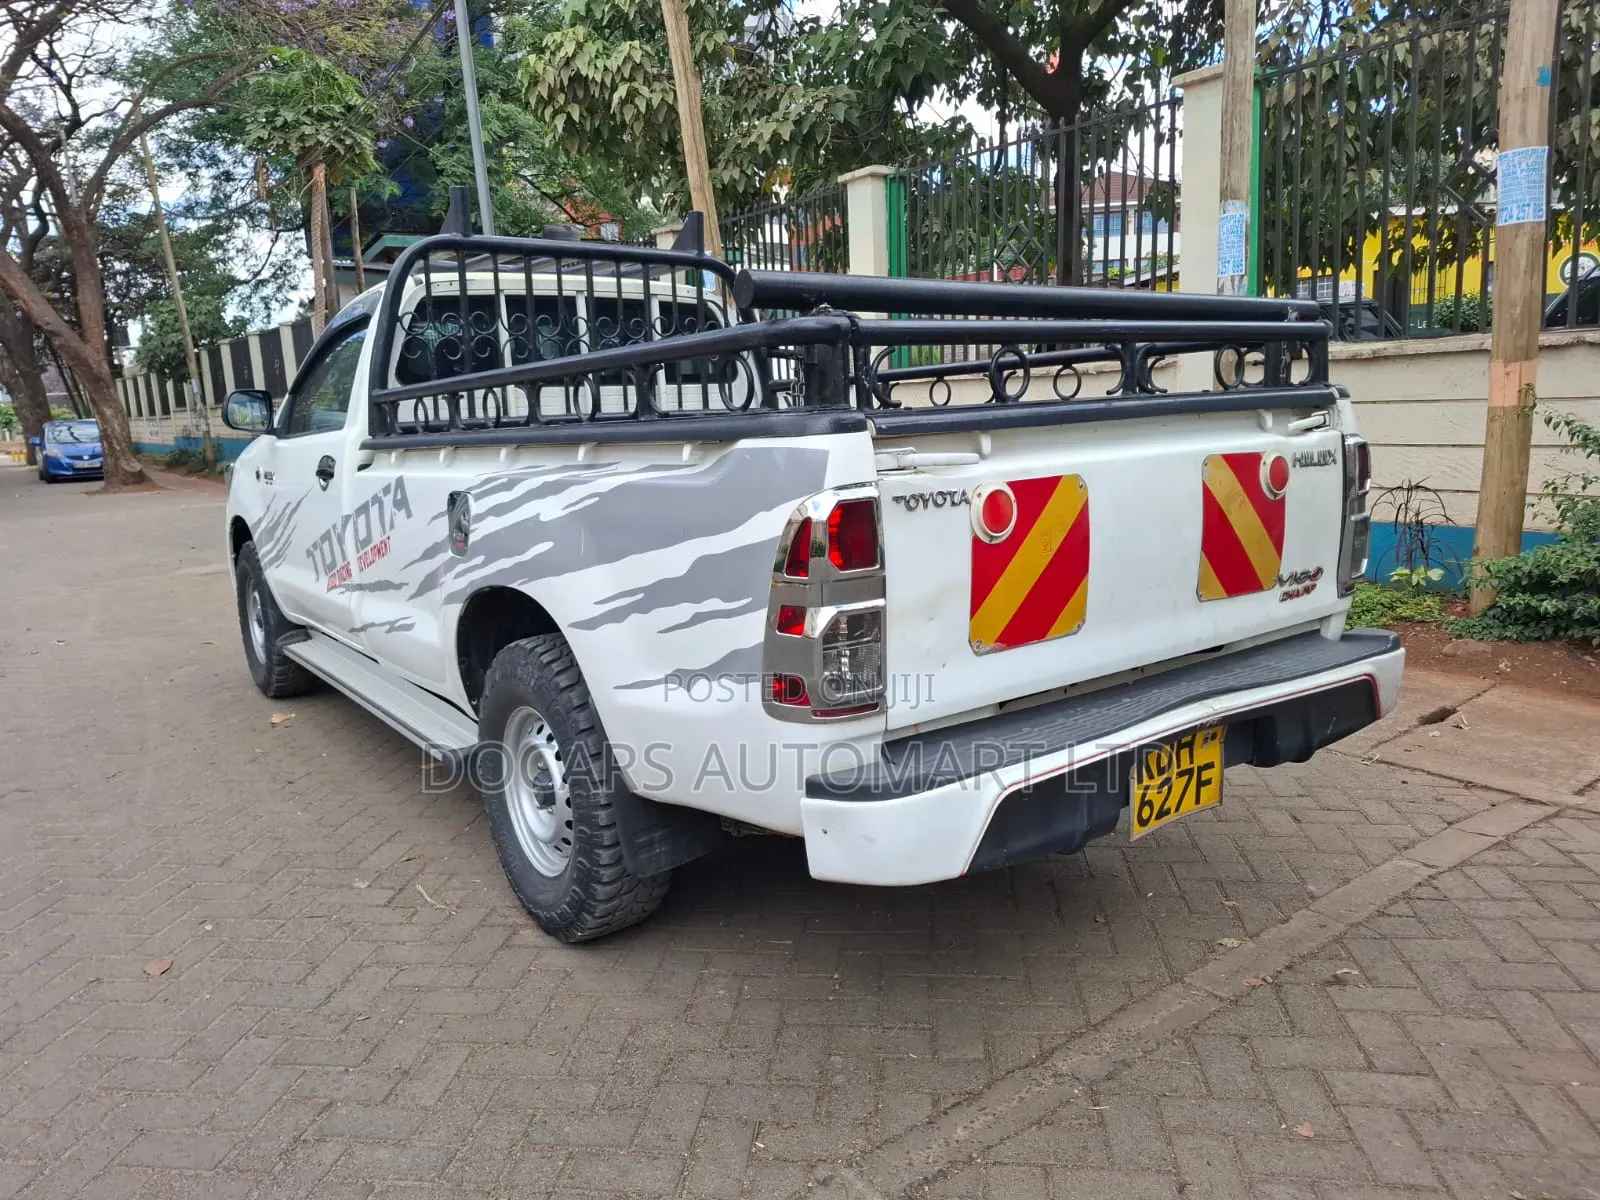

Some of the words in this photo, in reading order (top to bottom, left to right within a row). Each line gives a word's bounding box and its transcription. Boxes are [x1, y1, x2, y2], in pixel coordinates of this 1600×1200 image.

[1292, 449, 1338, 468] HILUX
[891, 488, 972, 513] TOYOTA
[304, 474, 413, 584] TOYOTA
[1136, 760, 1216, 828] 627F
